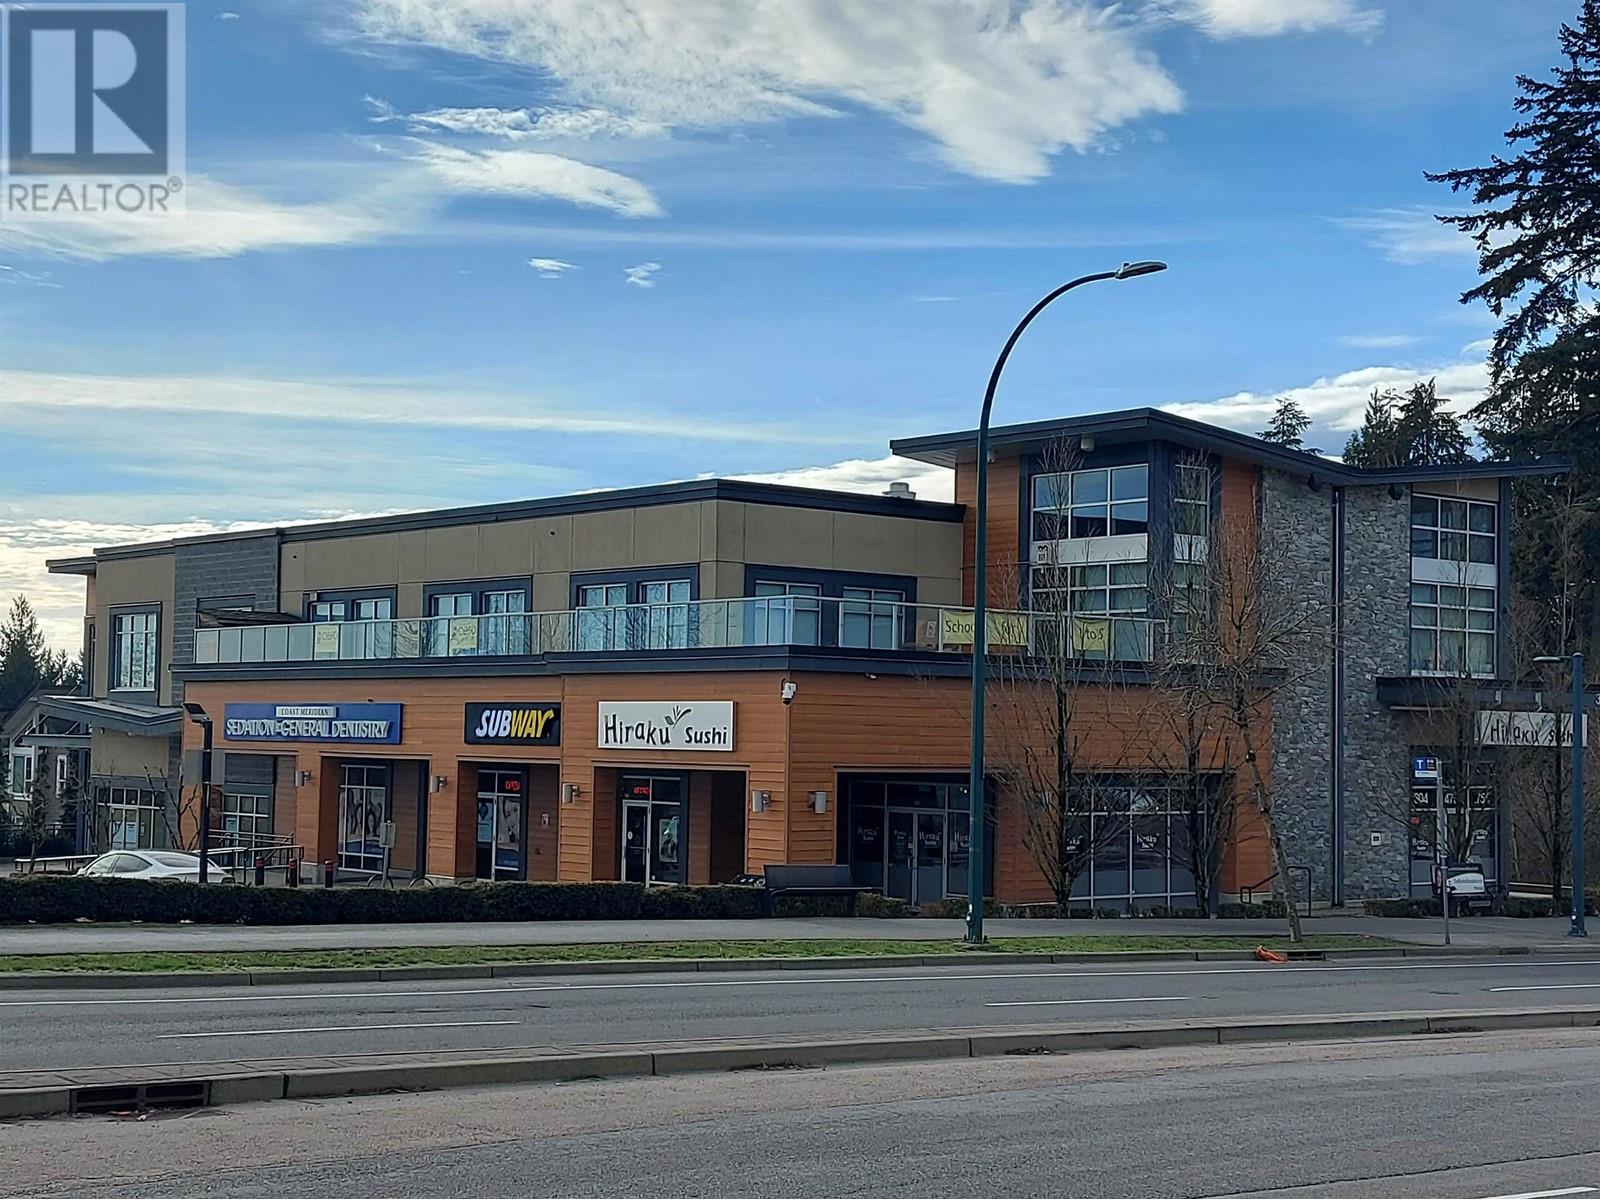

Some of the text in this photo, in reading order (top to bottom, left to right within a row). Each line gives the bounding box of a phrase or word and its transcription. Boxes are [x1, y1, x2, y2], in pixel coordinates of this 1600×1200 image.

[945, 620, 974, 633] Schoo
[281, 708, 329, 716] COAST MERIDIAN
[227, 719, 275, 736] SEDATION
[282, 719, 332, 737] GENERAL
[332, 720, 390, 738] DENTISTRY
[475, 708, 554, 738] SUBWAY
[604, 714, 727, 745] Hiraku Sushi
